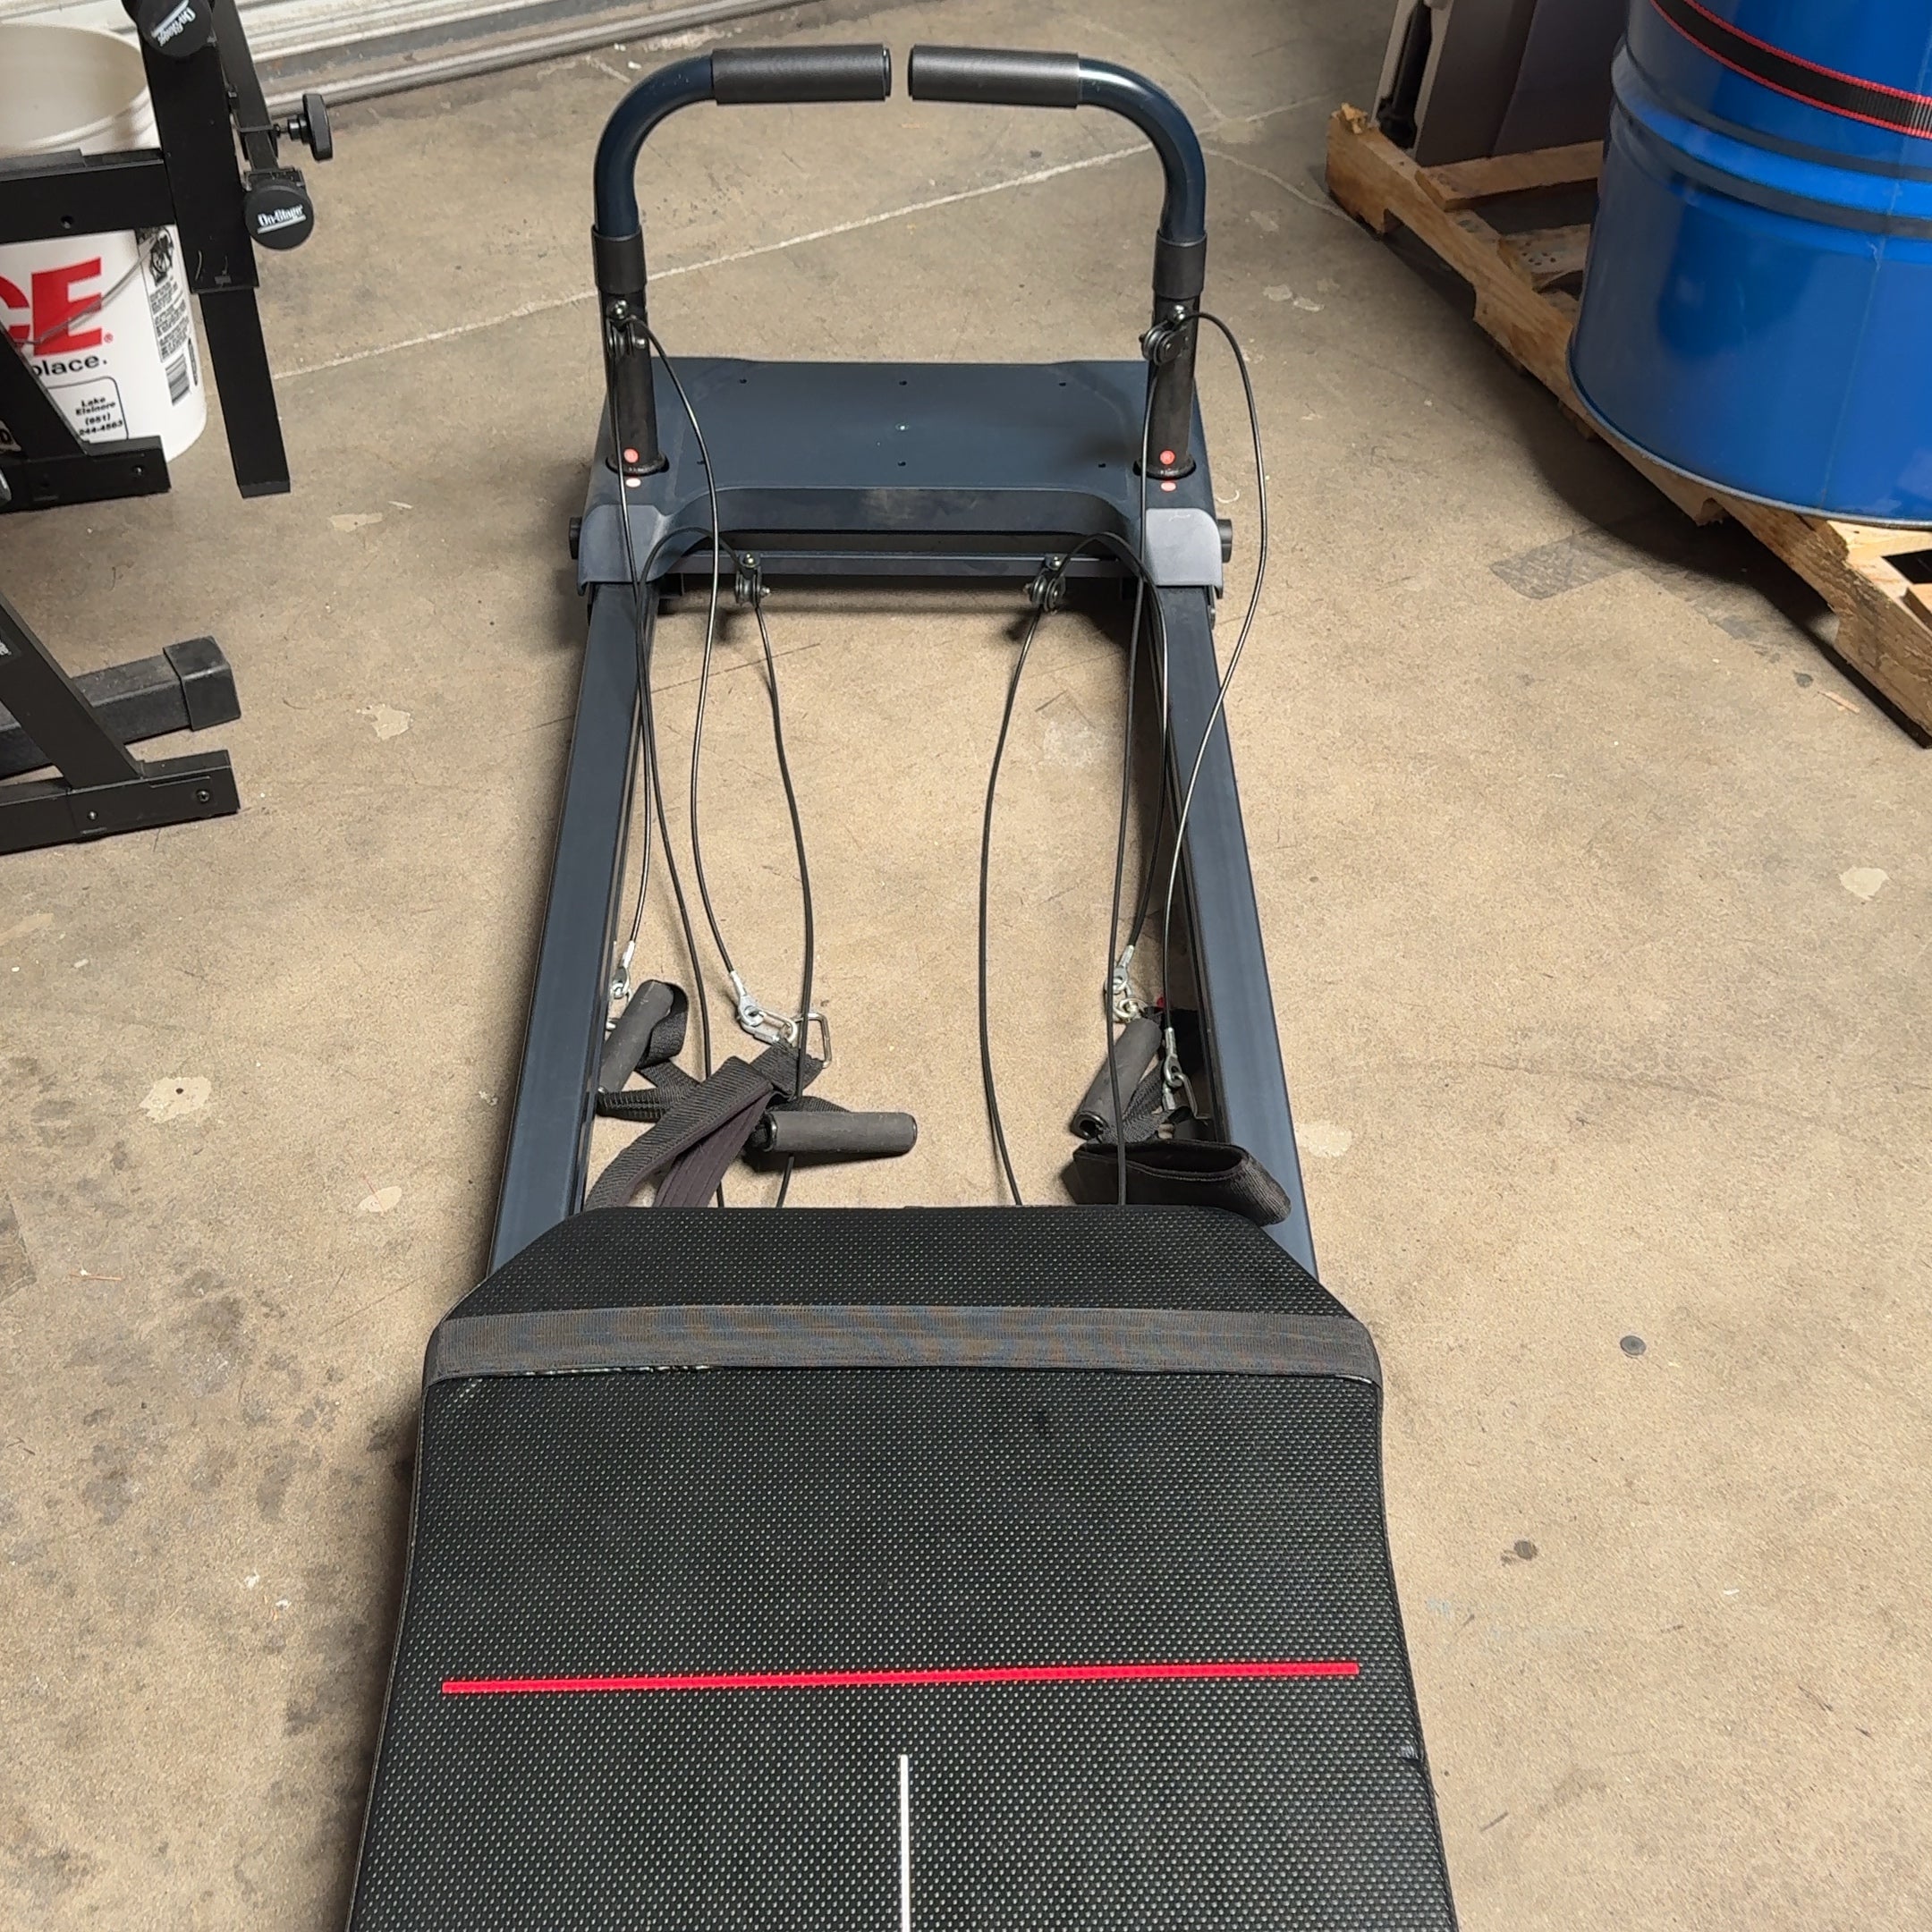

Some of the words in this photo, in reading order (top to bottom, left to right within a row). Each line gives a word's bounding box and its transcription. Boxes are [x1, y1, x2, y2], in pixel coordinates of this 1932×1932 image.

[258, 204, 303, 227] On-Stage
[76, 402, 115, 415] Elsinore
[81, 397, 106, 407] Lake
